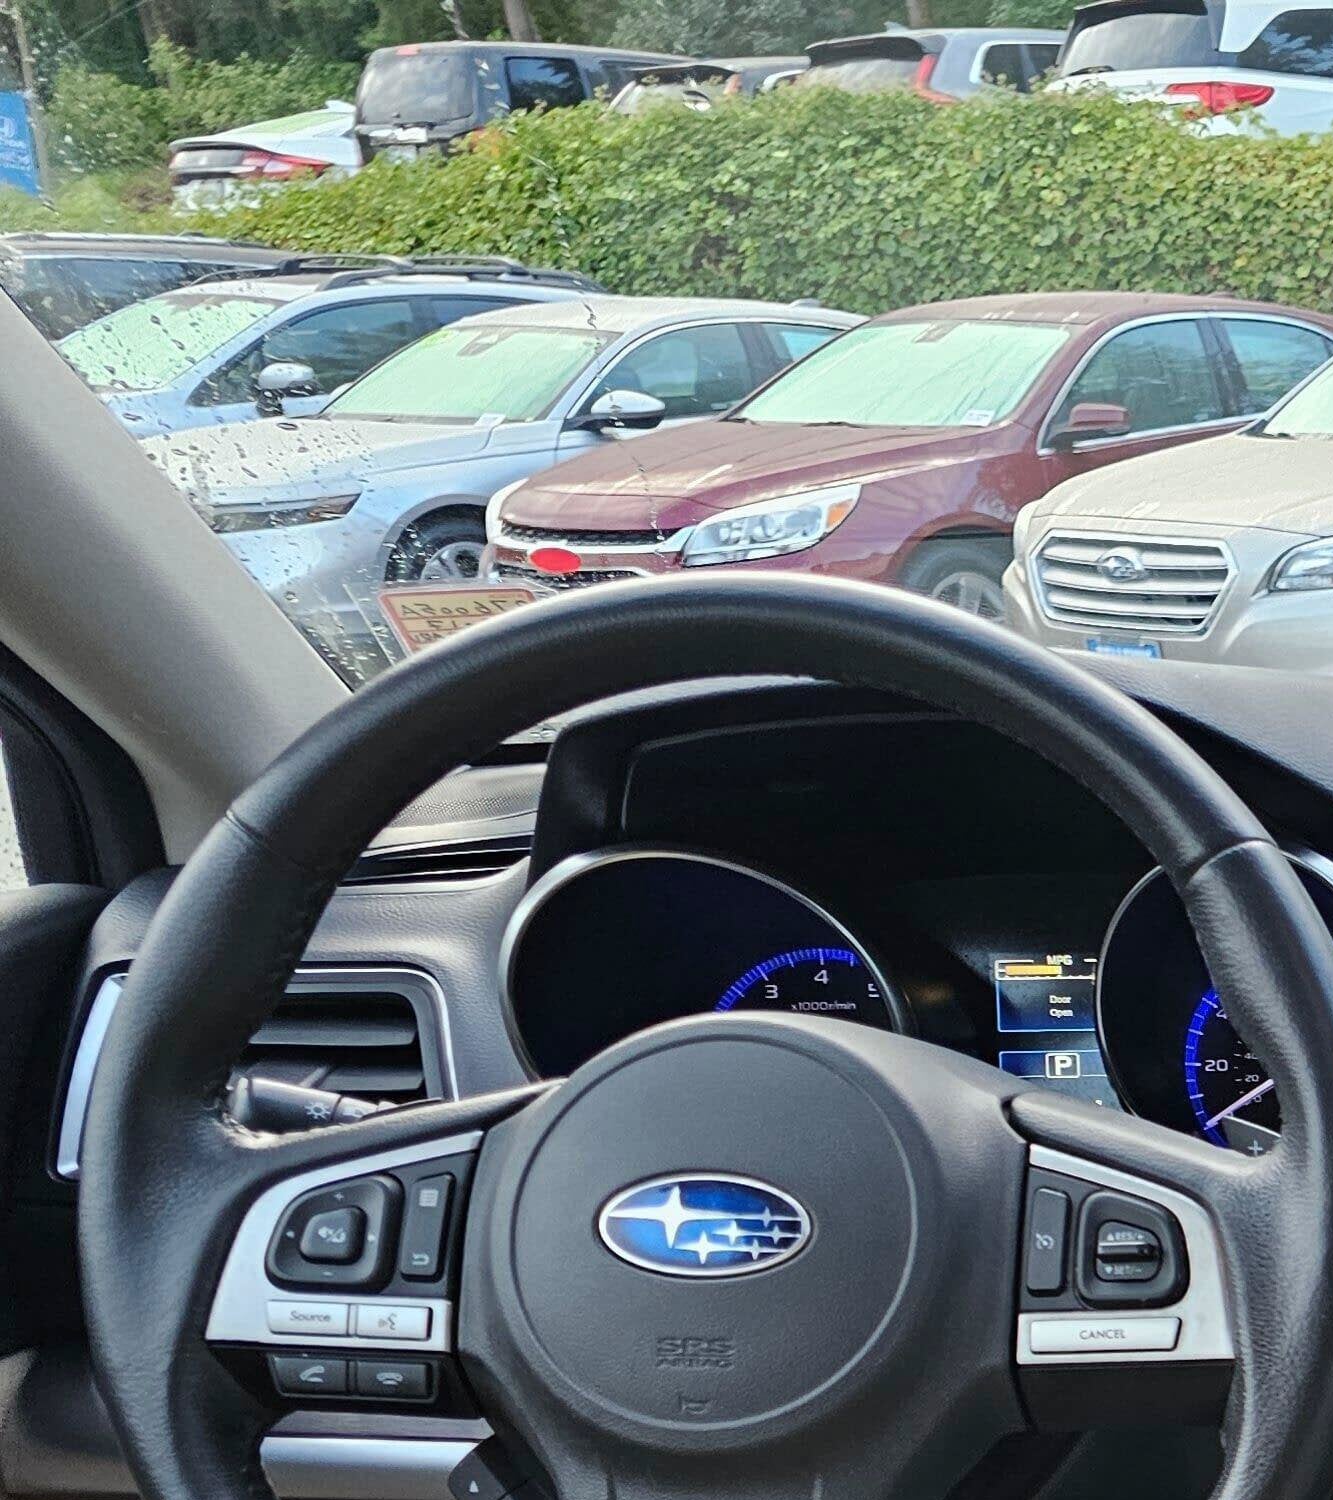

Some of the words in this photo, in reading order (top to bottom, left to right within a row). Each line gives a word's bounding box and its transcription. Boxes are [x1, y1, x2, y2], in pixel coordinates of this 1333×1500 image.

[813, 969, 829, 985] 4
[764, 984, 779, 999] 3
[1054, 1055, 1073, 1076] P
[1204, 1059, 1229, 1072] 20
[1078, 1328, 1127, 1340] CANCEL
